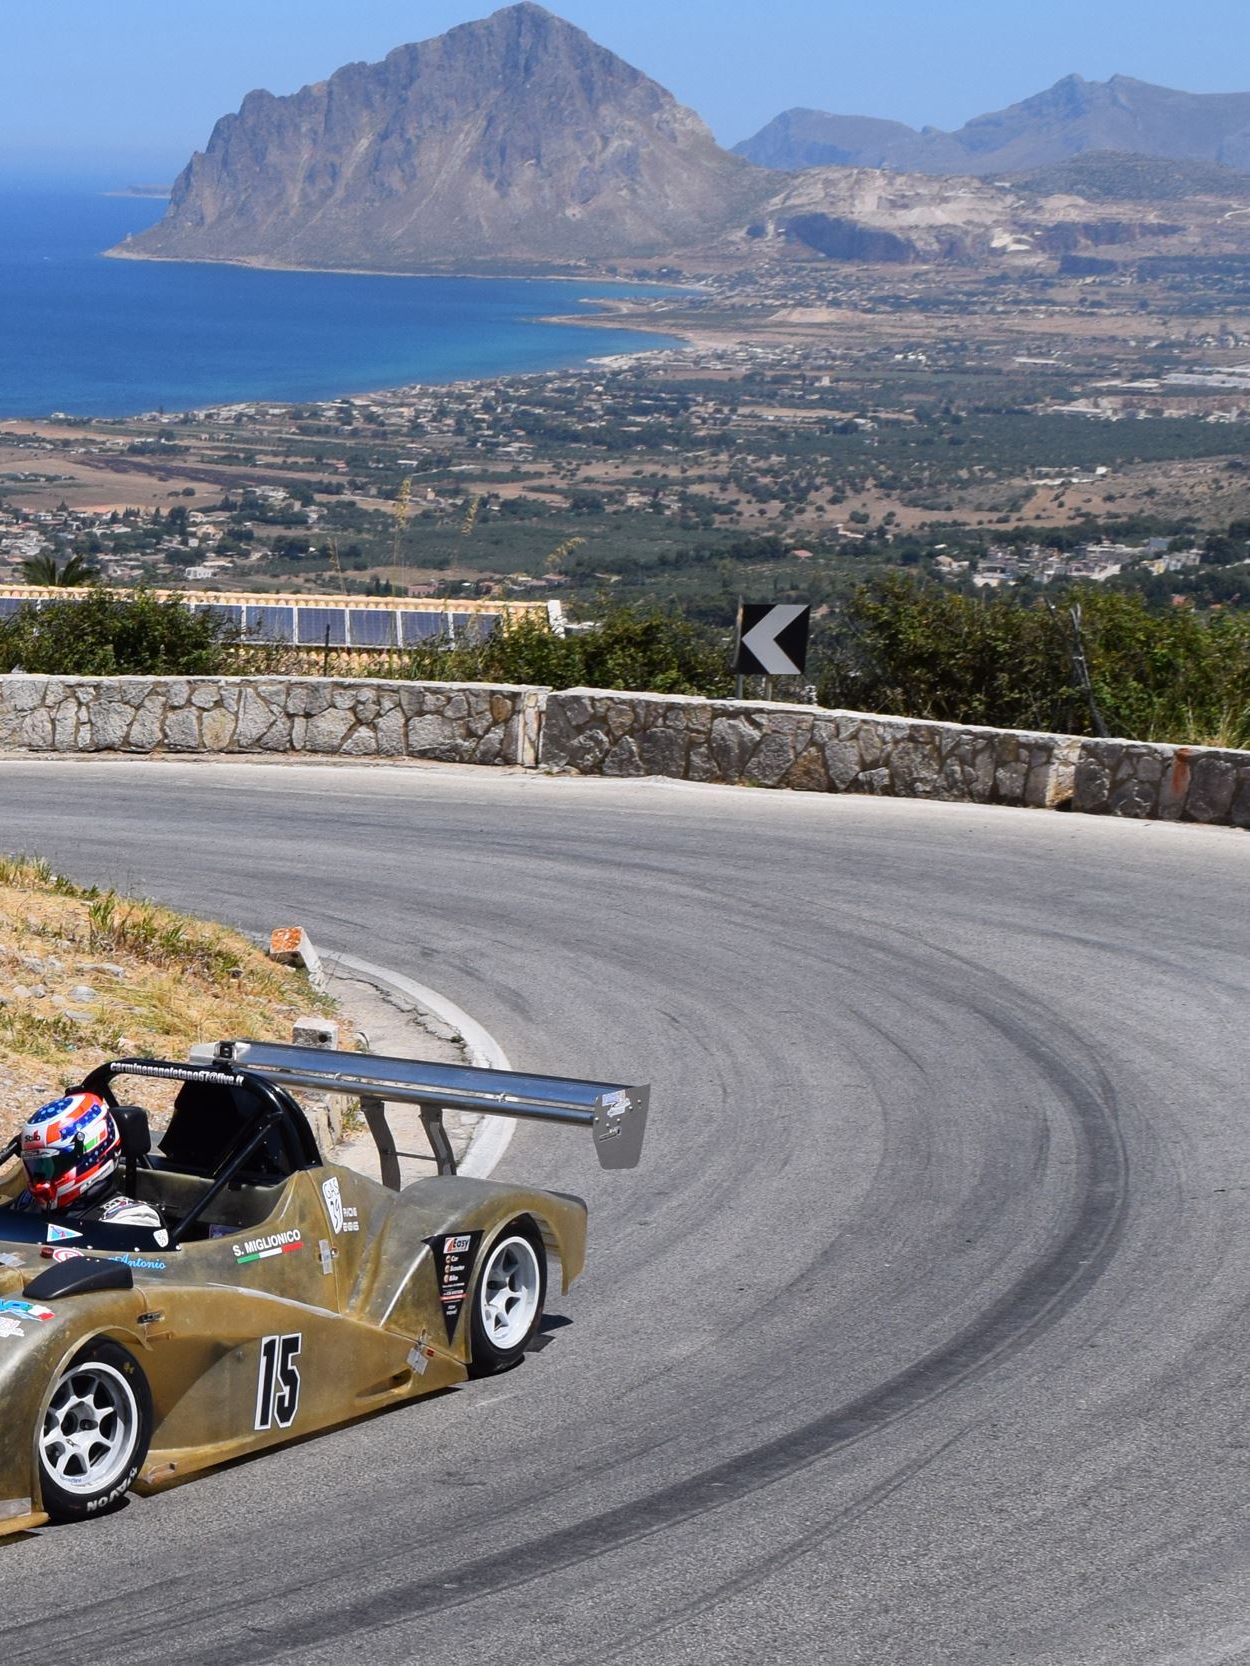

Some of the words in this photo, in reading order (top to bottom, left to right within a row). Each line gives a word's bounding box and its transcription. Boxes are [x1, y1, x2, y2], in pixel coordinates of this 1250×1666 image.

[232, 1245, 244, 1257] S.
[244, 1229, 301, 1253] MIGLIONICO
[453, 1238, 468, 1250] Easy
[108, 1253, 166, 1269] Antonio
[254, 1333, 302, 1430] 15
